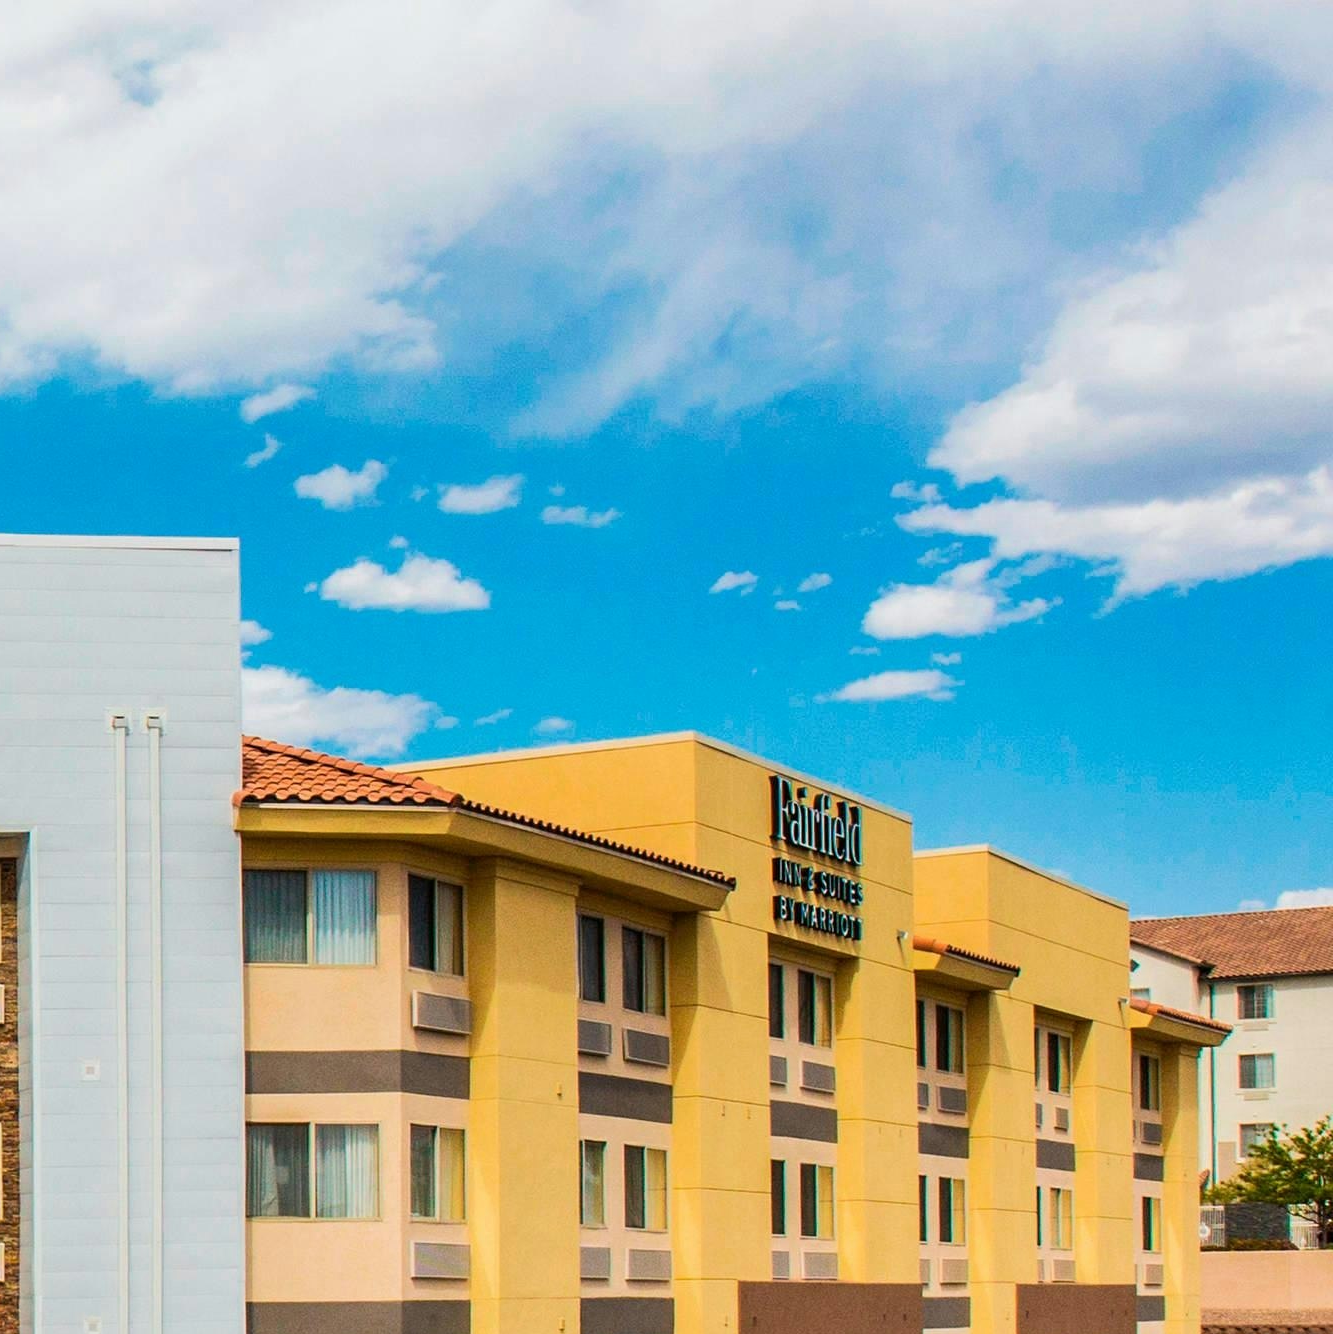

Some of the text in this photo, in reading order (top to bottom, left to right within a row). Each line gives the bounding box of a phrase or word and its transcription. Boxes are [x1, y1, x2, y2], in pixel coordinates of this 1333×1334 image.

[770, 775, 863, 866] Fairfield
[773, 857, 864, 906] INN & SUITES
[773, 895, 862, 941] BY MARRIOTT
